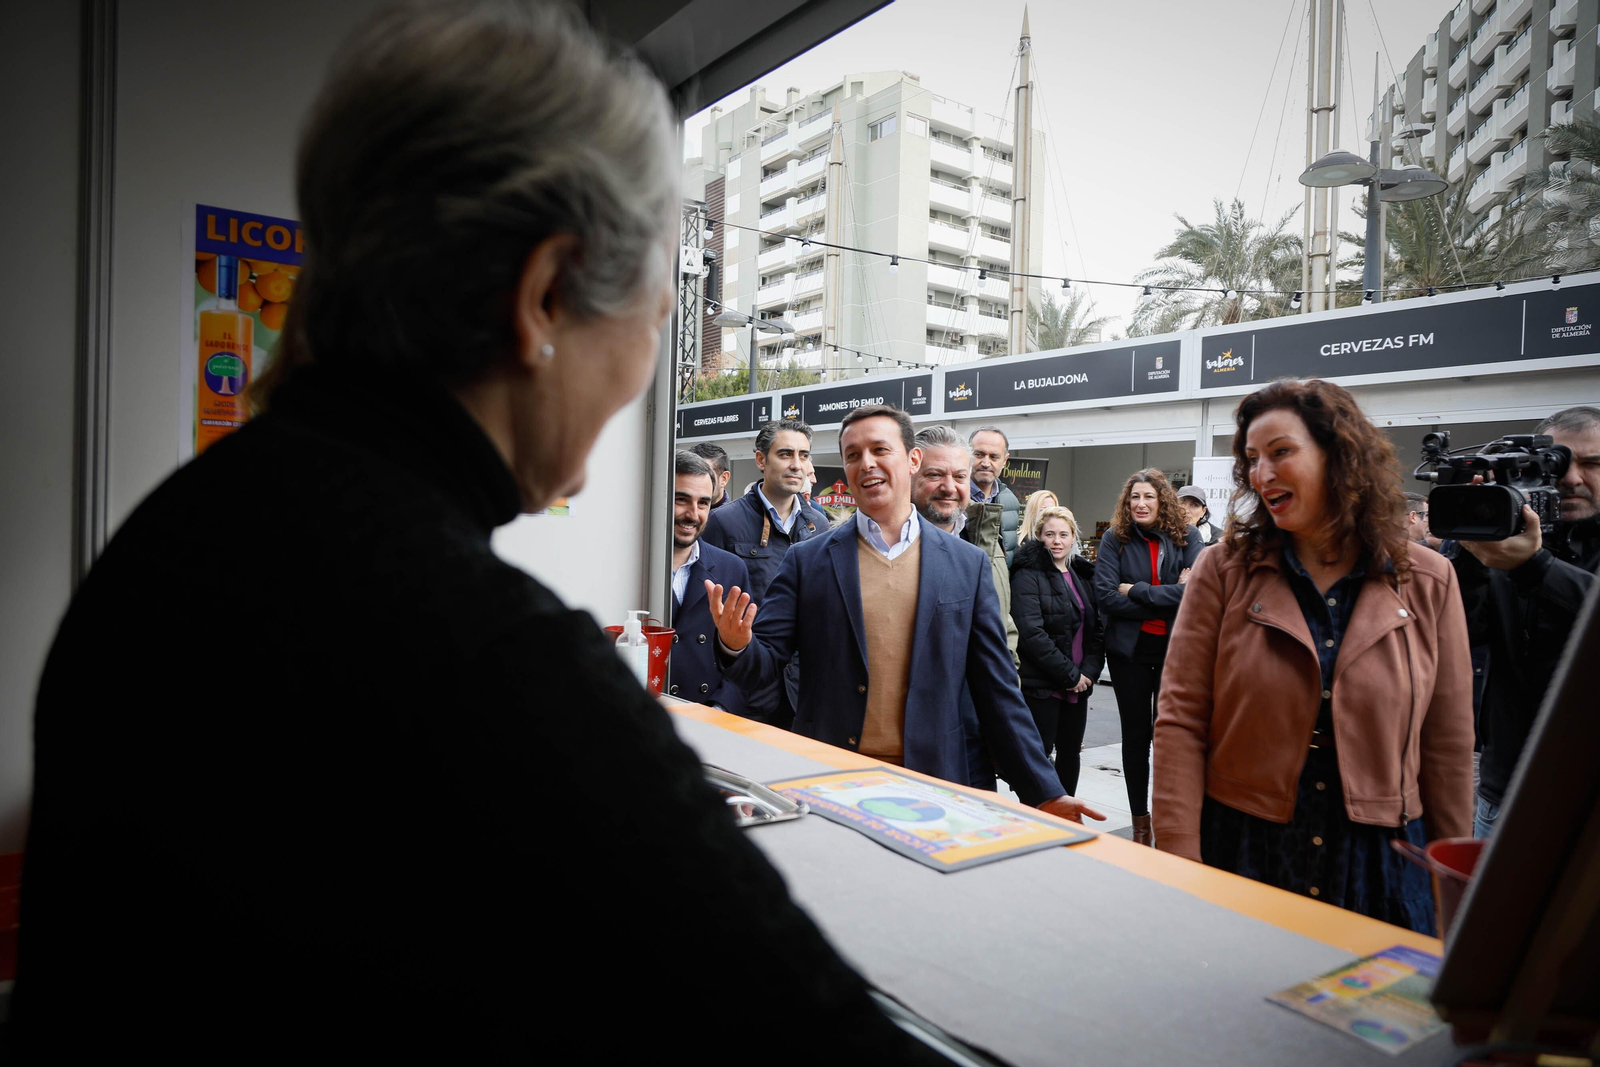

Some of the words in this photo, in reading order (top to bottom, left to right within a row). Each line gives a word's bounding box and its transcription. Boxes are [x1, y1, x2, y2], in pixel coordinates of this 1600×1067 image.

[1551, 324, 1592, 333] DIPUTACIÓN
[1320, 336, 1404, 356] CERVEZAS
[1408, 333, 1434, 347] FM
[1206, 356, 1244, 369] sabores
[1014, 380, 1026, 391] LA
[1028, 373, 1089, 389] BUJALDONA
[818, 401, 848, 412] JAMONES
[849, 398, 860, 408] TÍO
[860, 396, 884, 407] EMILIO
[694, 417, 716, 426] CERVEZAS
[717, 414, 739, 423] FILABRES
